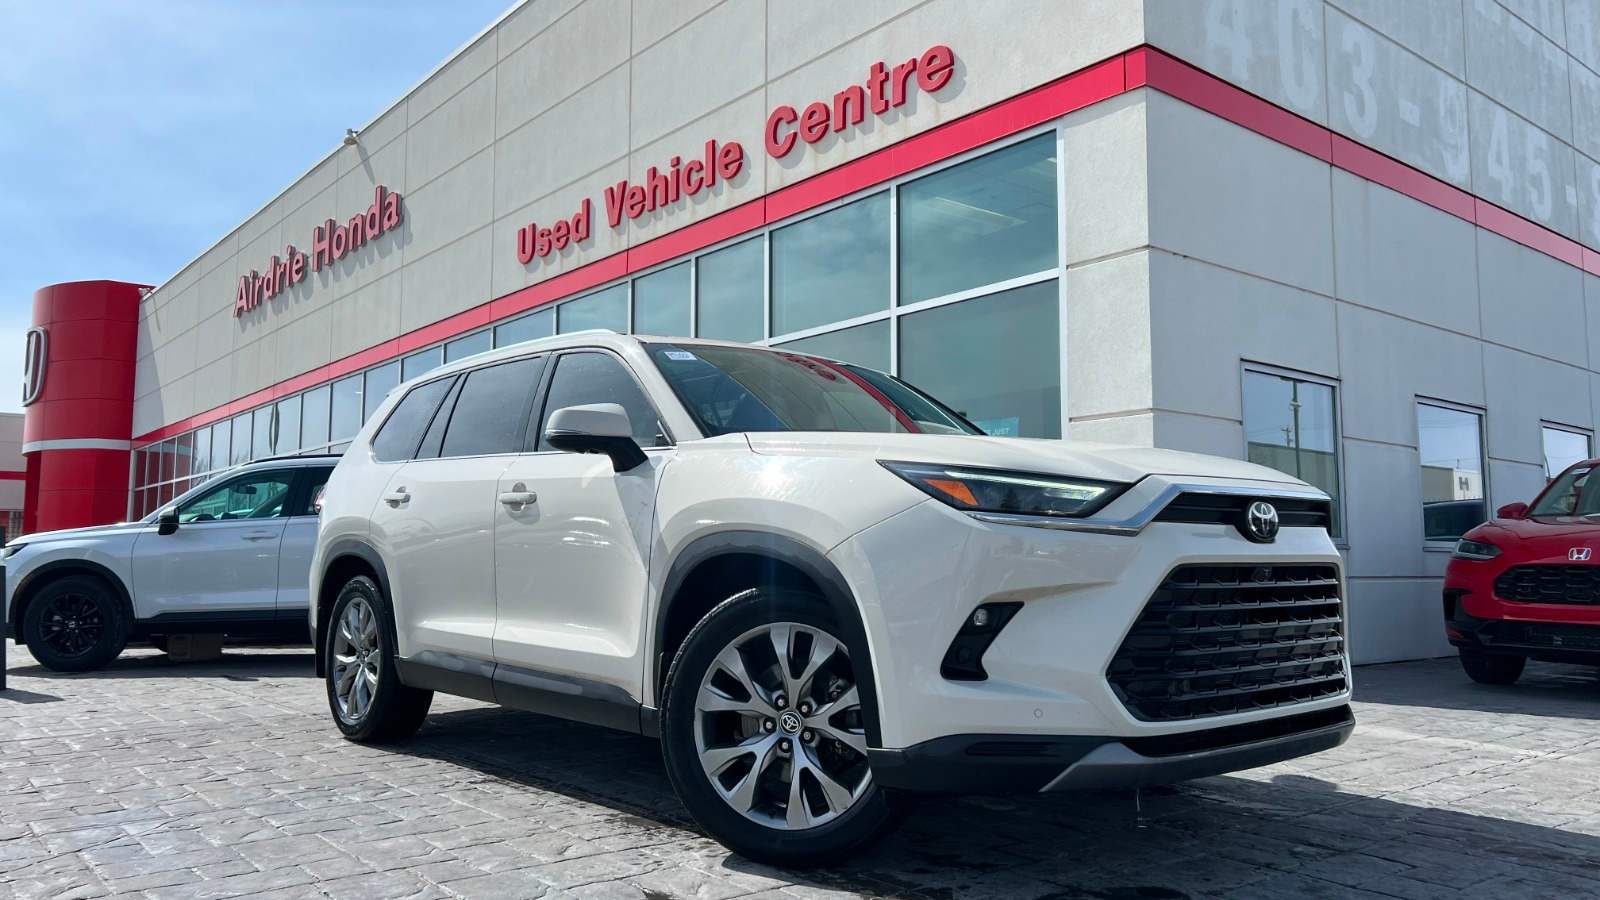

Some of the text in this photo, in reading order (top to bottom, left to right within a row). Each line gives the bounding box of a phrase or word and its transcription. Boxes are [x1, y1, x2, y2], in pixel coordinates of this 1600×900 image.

[516, 44, 956, 265] Used Vehicle Centre
[233, 185, 403, 318] Airdrie Honda
